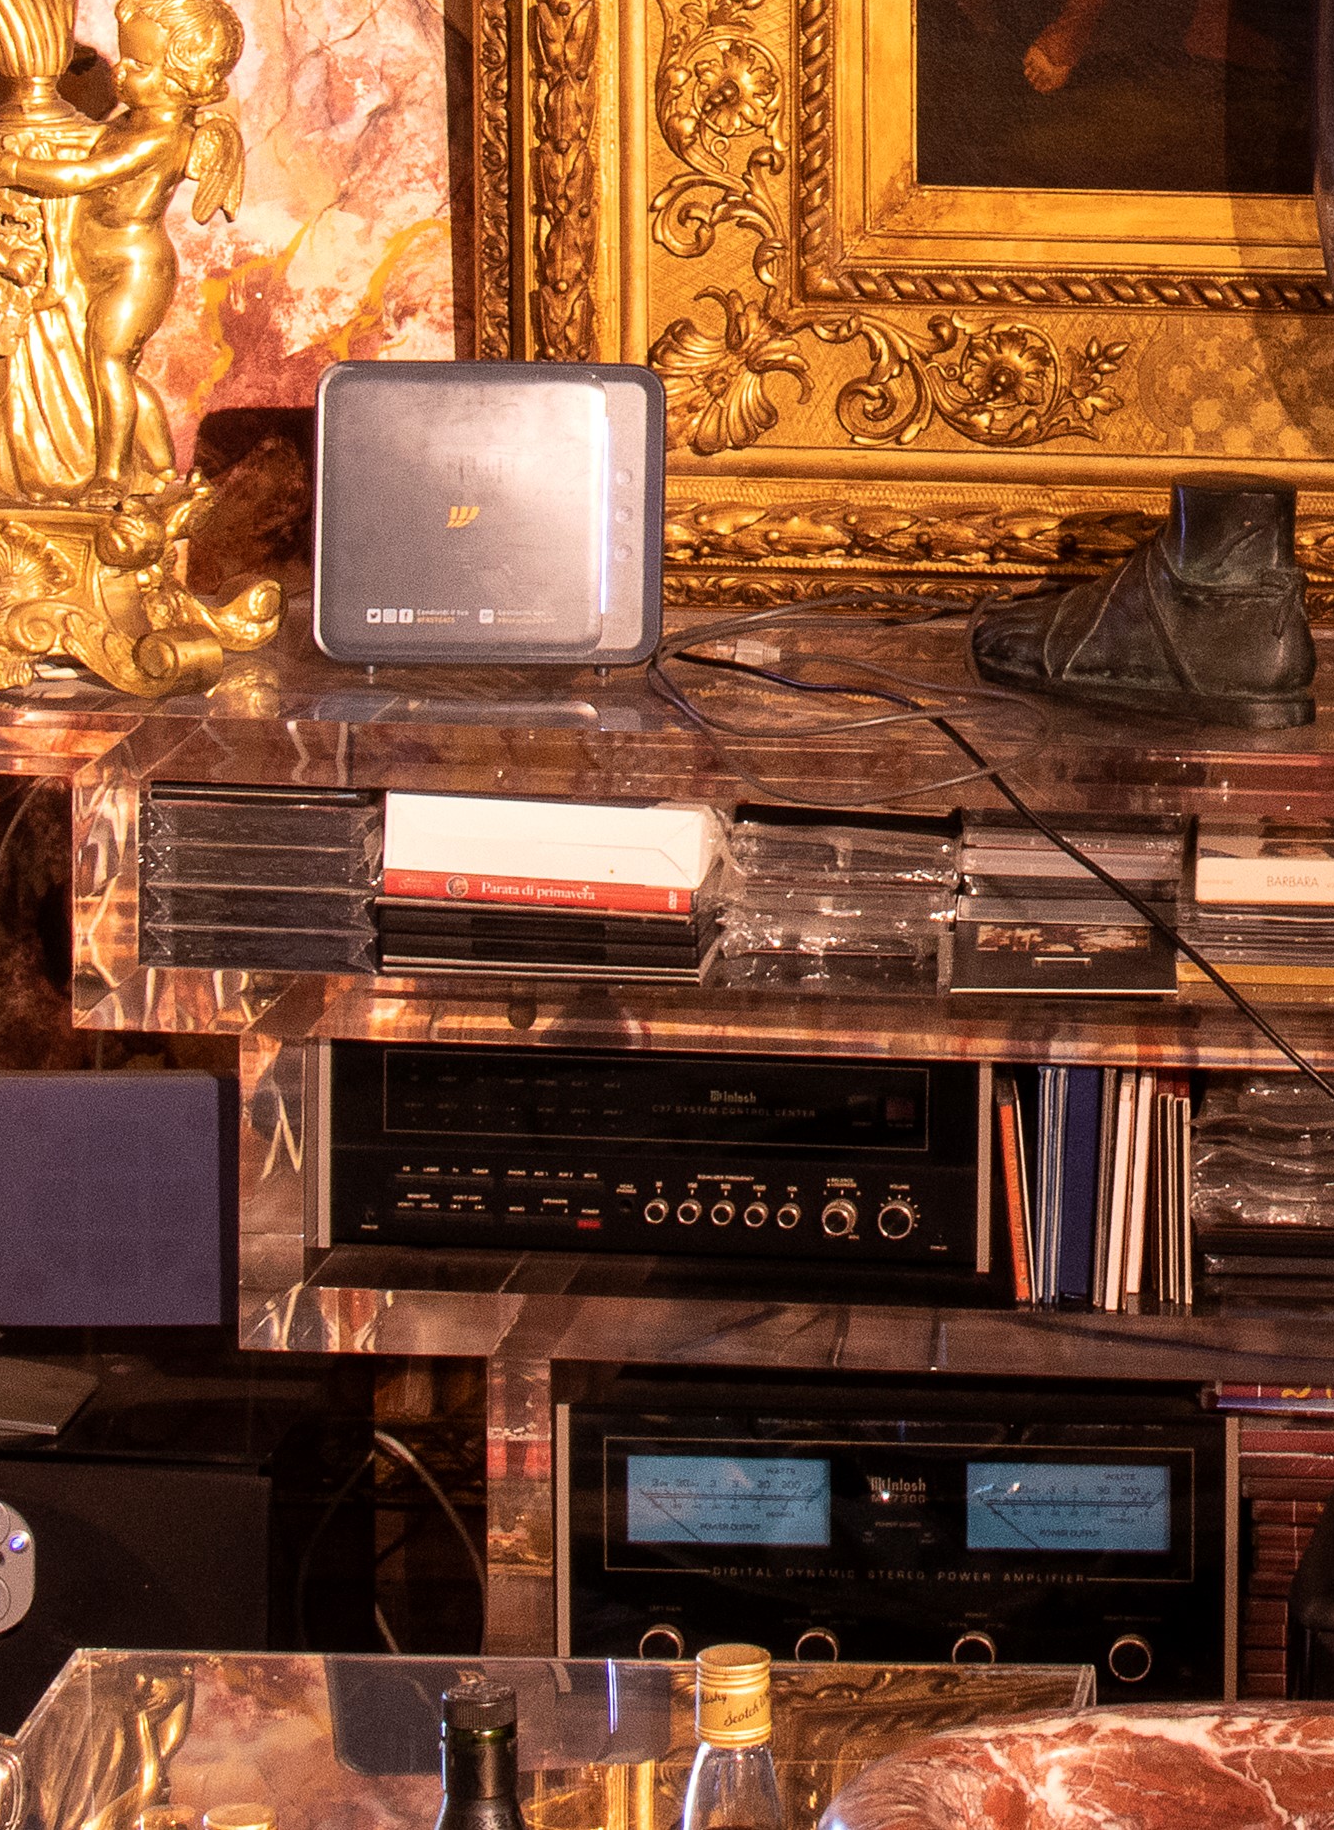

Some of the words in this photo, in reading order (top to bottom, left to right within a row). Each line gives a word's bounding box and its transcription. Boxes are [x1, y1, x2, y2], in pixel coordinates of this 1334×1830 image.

[481, 881, 520, 895] Parata
[522, 885, 534, 896] di
[1266, 875, 1319, 888] BARBARA
[870, 1494, 926, 1504] M7300
[712, 1566, 773, 1579] DIGITAL
[785, 1568, 855, 1580] DYNAMIC
[867, 1570, 926, 1581] STEREO
[937, 1571, 991, 1582] POWER
[1003, 1572, 1085, 1584] AMPLIFIER
[723, 1698, 759, 1727] Scotch
